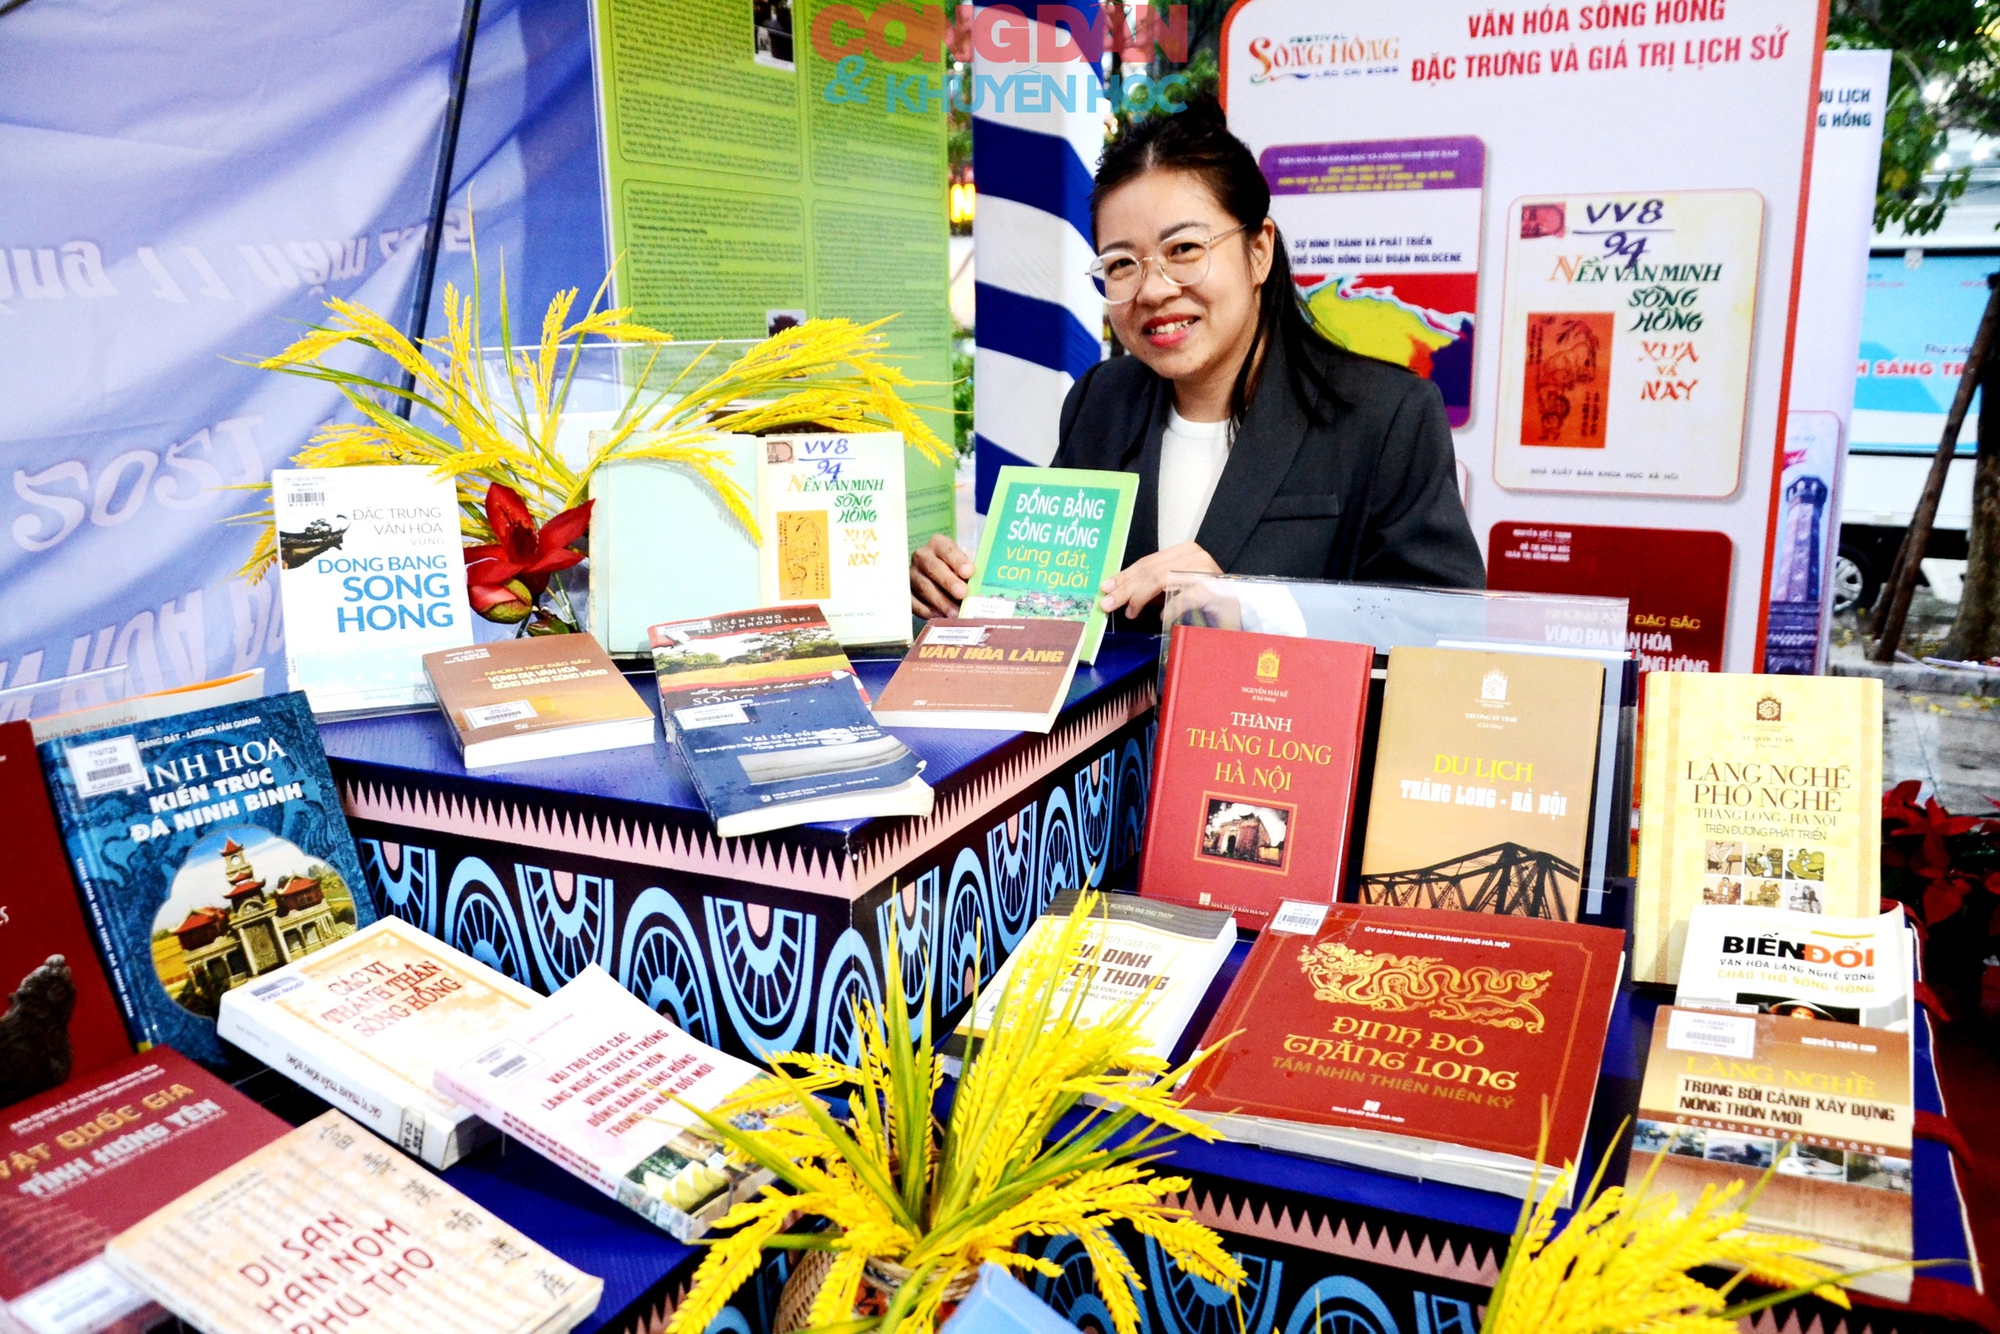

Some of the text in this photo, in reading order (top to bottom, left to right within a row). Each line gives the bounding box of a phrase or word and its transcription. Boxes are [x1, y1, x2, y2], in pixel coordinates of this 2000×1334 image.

[1469, 8, 1513, 38] VĂN
[1522, 4, 1569, 33] HÓA
[1412, 23, 1789, 86] ĐẶC TRƯNG VÀ GIÁ TRỊ LỊCH SỬ
[1603, 232, 1651, 270] 94
[1548, 255, 1608, 284] NỀN
[1661, 262, 1723, 282] MINH
[1628, 284, 1699, 308] SÔNG
[1628, 306, 1704, 332] HỒNG
[1638, 340, 1700, 363] XƯA
[1657, 362, 1679, 376] VÀ
[1641, 378, 1699, 401] NAY
[787, 473, 822, 492] NỀN
[851, 479, 884, 491] MINH
[817, 458, 844, 484] 94
[390, 506, 442, 519] TRƯNG
[834, 493, 873, 508] SÔNG
[836, 506, 878, 523] HỒNG
[1016, 486, 1106, 519] ĐỒNG BẰNG
[409, 520, 443, 534] HÓA
[844, 528, 878, 542] XƯA
[1007, 516, 1100, 548] SÔNG HỒNG
[847, 552, 879, 566] NAY
[1006, 544, 1090, 569] vùng đất,
[997, 565, 1090, 589] con người
[739, 616, 812, 629] KROWOLSKI
[919, 644, 1065, 663] VĂN HÓA LÀNG
[1230, 711, 1292, 733] THÀNH
[214, 737, 288, 773] HOA
[1186, 727, 1333, 765] THĂNG LONG
[1214, 759, 1292, 794] HÀ NỘI
[1433, 753, 1535, 783] DU LỊCH
[1685, 757, 1851, 789] LÀNG NGHỀ
[149, 767, 275, 814] KIẾN TRÚC
[1400, 777, 1451, 804] THĂNG
[1455, 785, 1498, 808] LONG
[1510, 788, 1533, 813] HÀ
[1538, 790, 1568, 820] NỘI
[1692, 782, 1842, 812] PHỐ NGHỀ
[130, 782, 304, 842] ĐÁ NINH BÌNH
[1744, 810, 1781, 823] LONG
[1813, 813, 1837, 827] NỘI
[1704, 823, 1730, 835] TRÊN
[1798, 827, 1827, 841] TRIỂN
[1393, 929, 1417, 938] NHÂN
[1417, 932, 1435, 940] DÂN
[1435, 934, 1463, 943] THÀNH
[1463, 937, 1482, 946] PHỐ
[1482, 939, 1494, 947] HÀ
[1494, 941, 1511, 950] NỘI
[1722, 932, 1874, 969] BIẾN ĐỔI
[328, 971, 372, 995] CÁC
[361, 960, 398, 977] VỊ
[353, 977, 463, 1038] SÔNG HỒNG
[1332, 1014, 1486, 1057] ĐỊNH ĐÔ
[546, 1069, 571, 1086] VAI
[565, 1056, 591, 1074] TRÒ
[606, 1030, 632, 1048] CÁC
[610, 1067, 643, 1090] NÔNG
[637, 1051, 668, 1072] THÔN
[1283, 1031, 1519, 1092] THĂNG LONG
[1272, 1055, 1314, 1075] TẦM
[1318, 1063, 1365, 1083] NHÌN
[1369, 1072, 1431, 1096] THIÊN
[1433, 1081, 1483, 1104] NIÊN
[1686, 1055, 1878, 1098] LÀNG NGHỀ
[141, 1083, 195, 1111] GIA
[541, 1089, 574, 1111] LÀNG
[1679, 1095, 1804, 1126] NÔNG THÔN MỚI
[1683, 1077, 1734, 1099] TRONG
[1766, 1088, 1811, 1110] CẢNH
[1815, 1096, 1847, 1115] XÂY
[1851, 1103, 1896, 1123] DỰNG
[163, 1098, 223, 1128] YÊN
[605, 1111, 644, 1138] TRONG
[639, 1100, 659, 1116] 30
